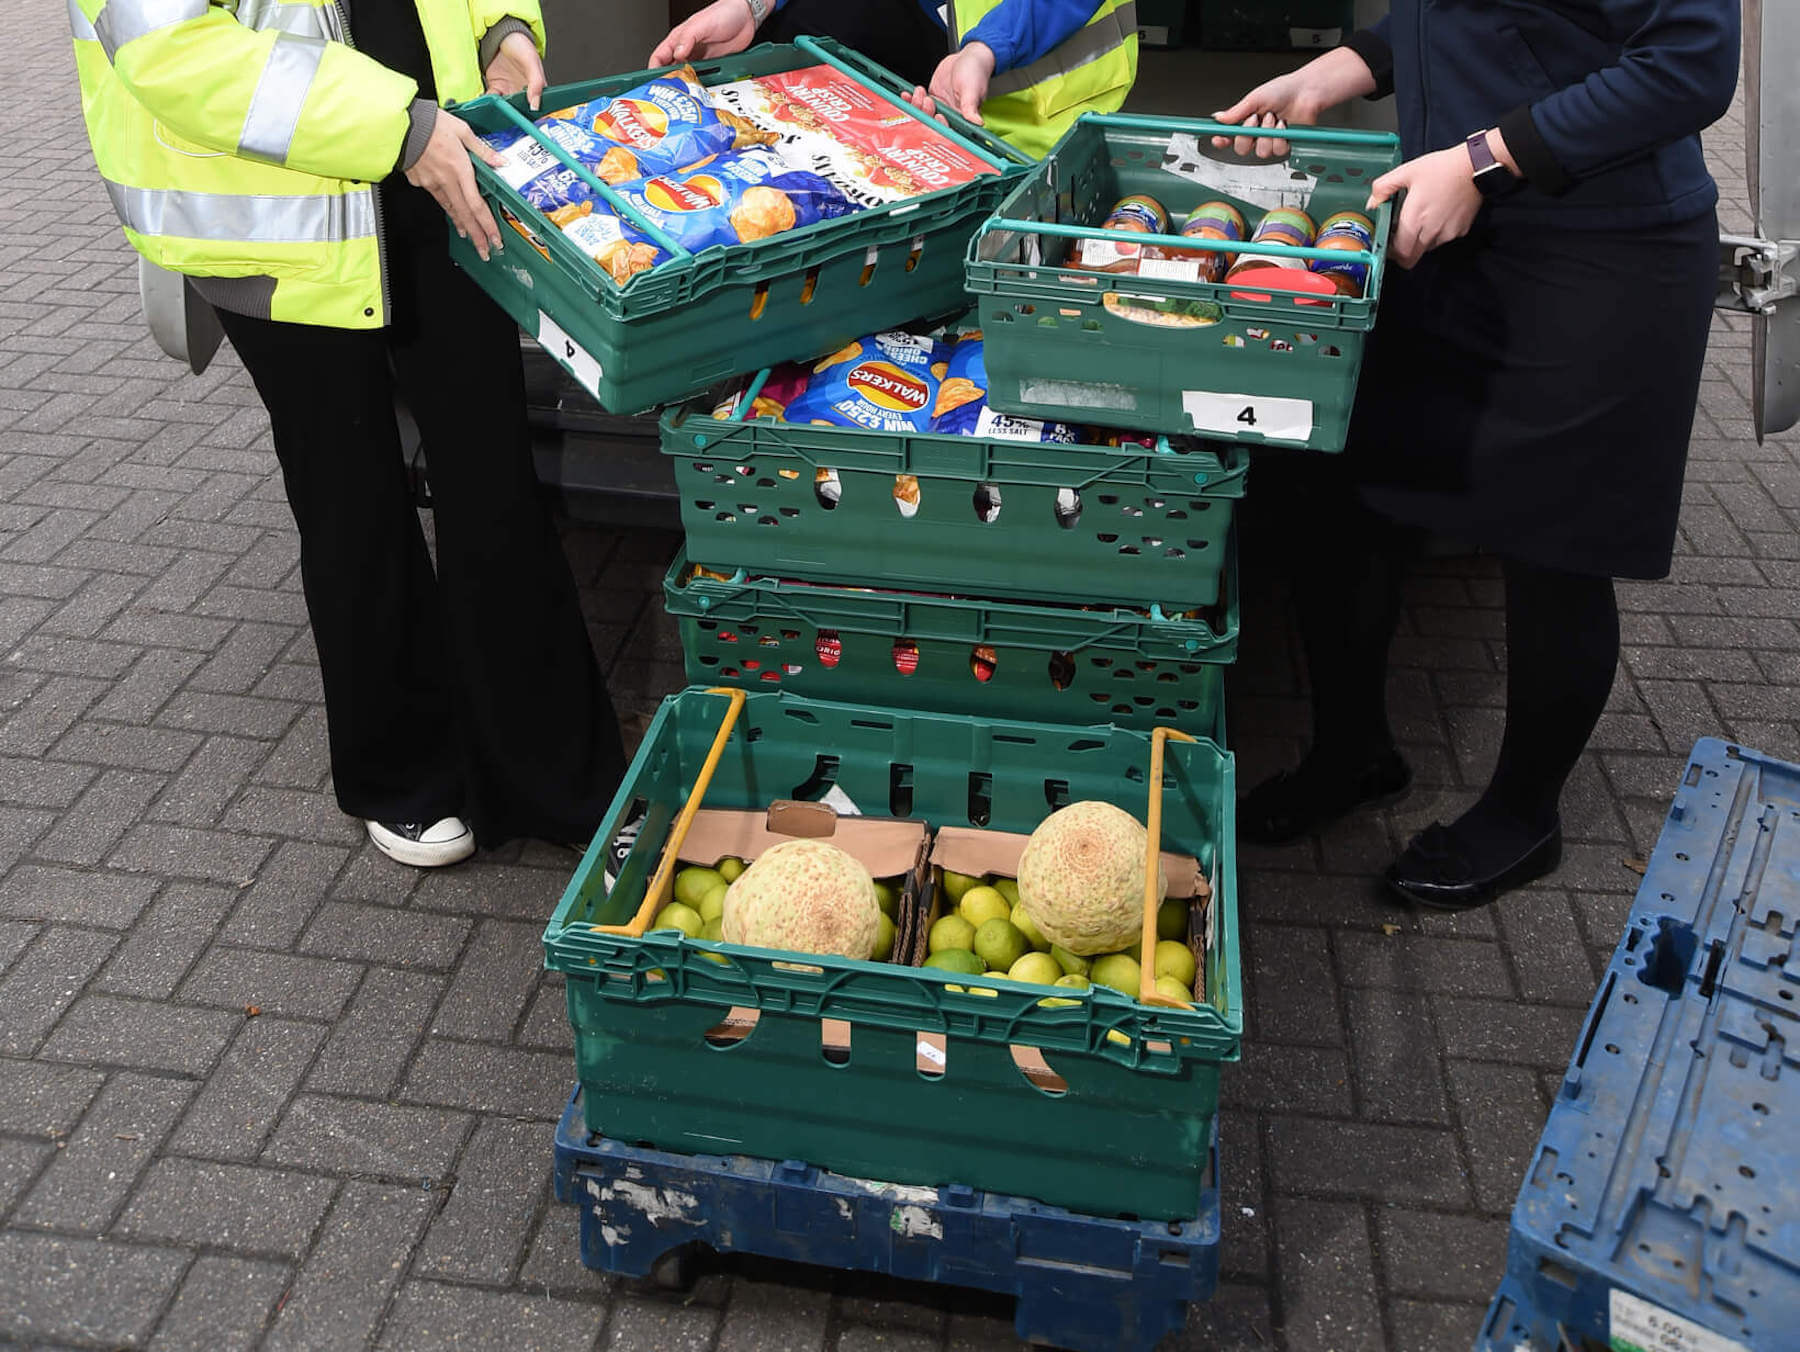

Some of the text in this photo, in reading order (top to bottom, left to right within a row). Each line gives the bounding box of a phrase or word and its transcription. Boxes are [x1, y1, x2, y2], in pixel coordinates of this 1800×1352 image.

[785, 85, 849, 122] COUNTRY
[812, 88, 852, 111] CRISP
[608, 100, 655, 148] WALKERS
[878, 146, 949, 185] COUNTRY
[907, 149, 950, 173] CRISP
[565, 339, 575, 358] 4
[851, 369, 926, 406] WALKERS
[1237, 406, 1257, 426] 4
